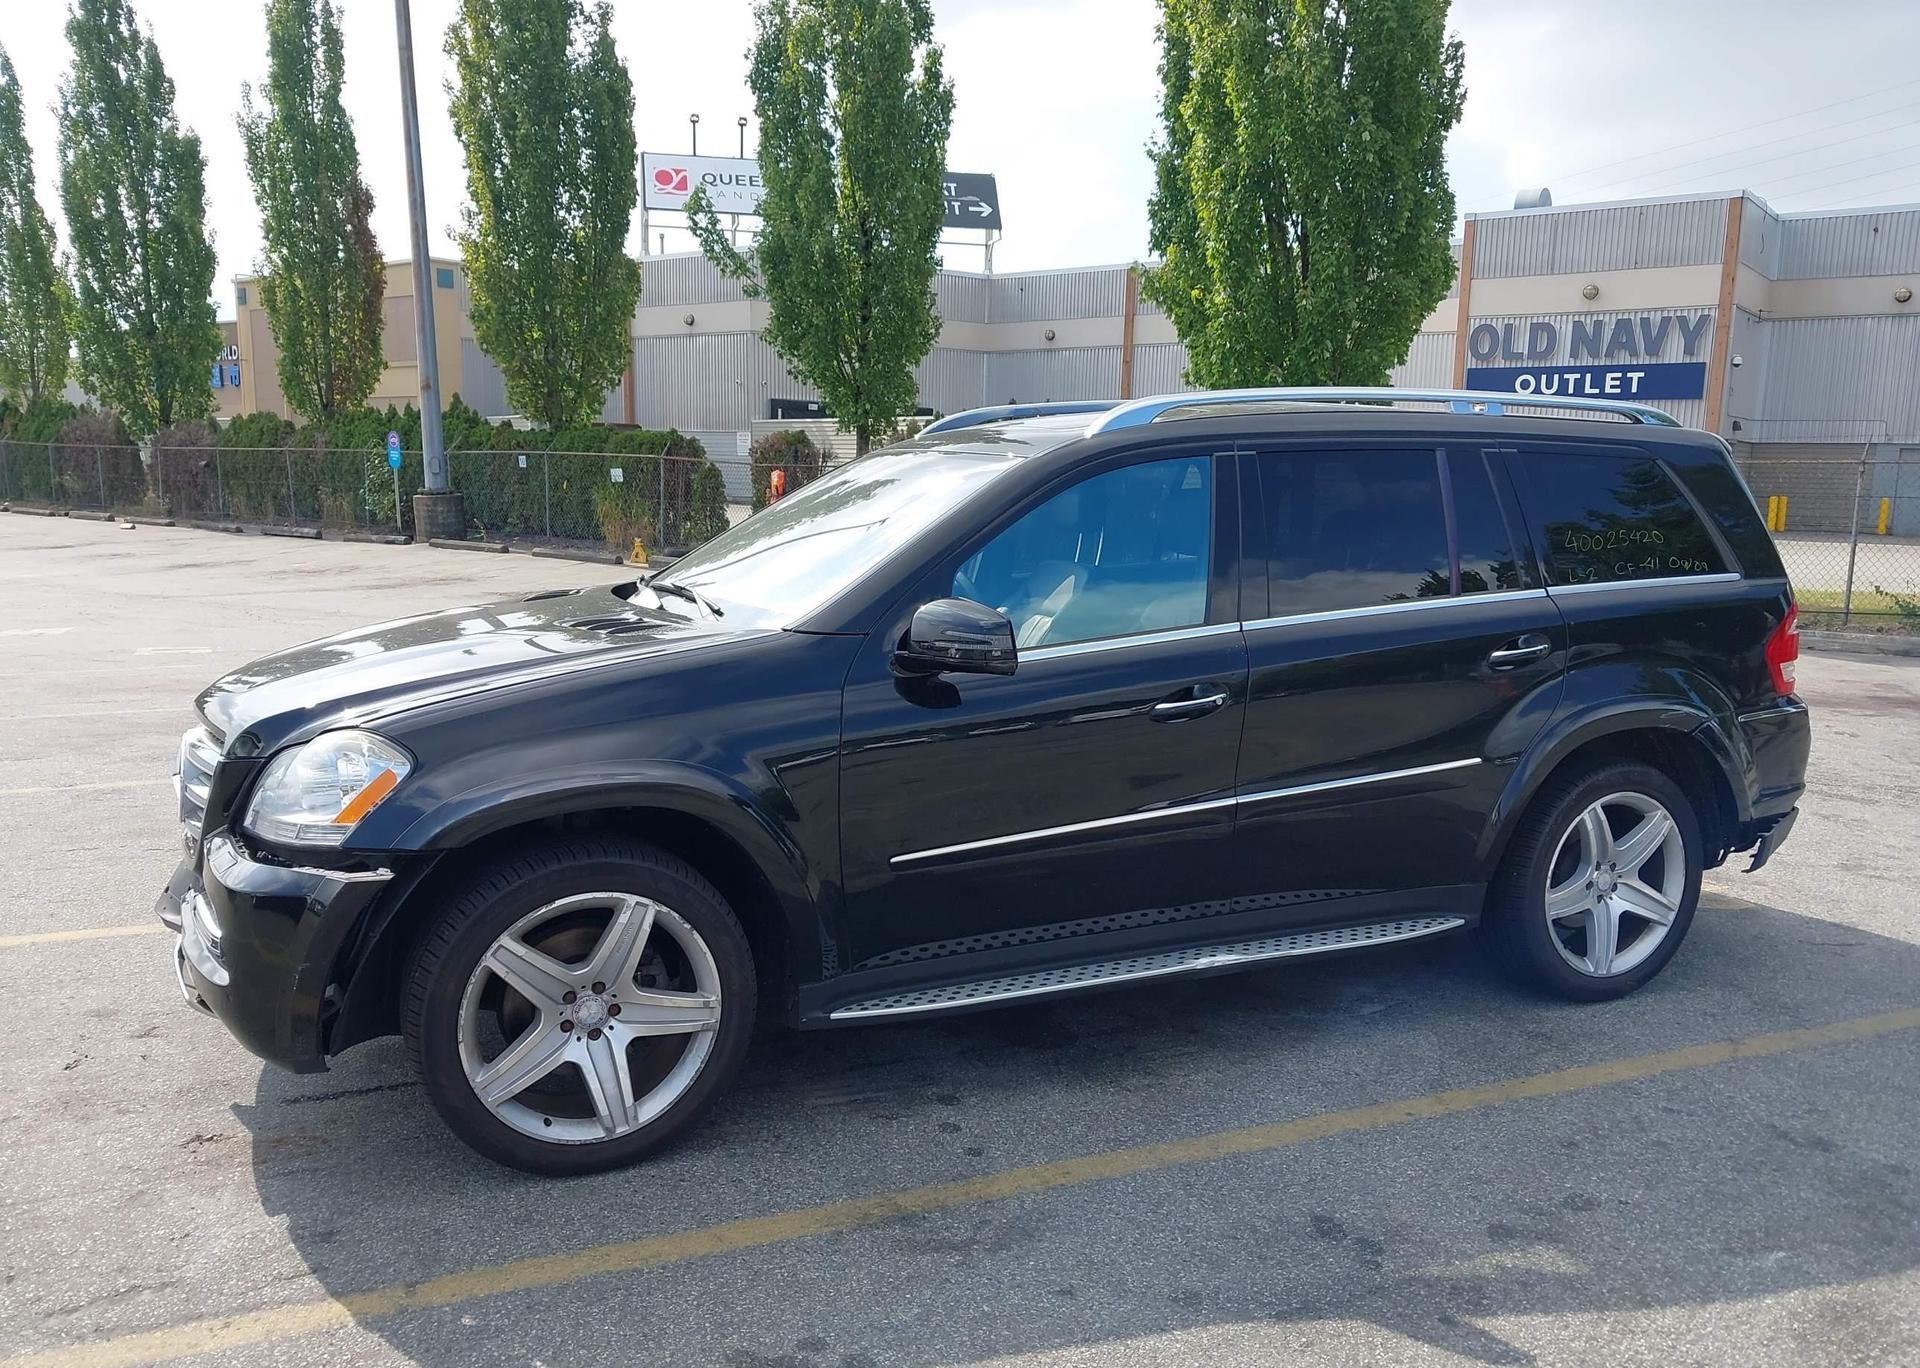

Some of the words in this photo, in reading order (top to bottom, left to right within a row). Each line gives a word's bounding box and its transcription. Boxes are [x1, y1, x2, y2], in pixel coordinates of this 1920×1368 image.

[702, 172, 761, 187] QUEE
[942, 182, 958, 196] XT
[710, 190, 760, 201] AND
[1469, 322, 1558, 361] OLD
[1569, 314, 1712, 360] NAVY
[1514, 371, 1645, 395] OUTLET
[1564, 529, 1664, 553] 40025420
